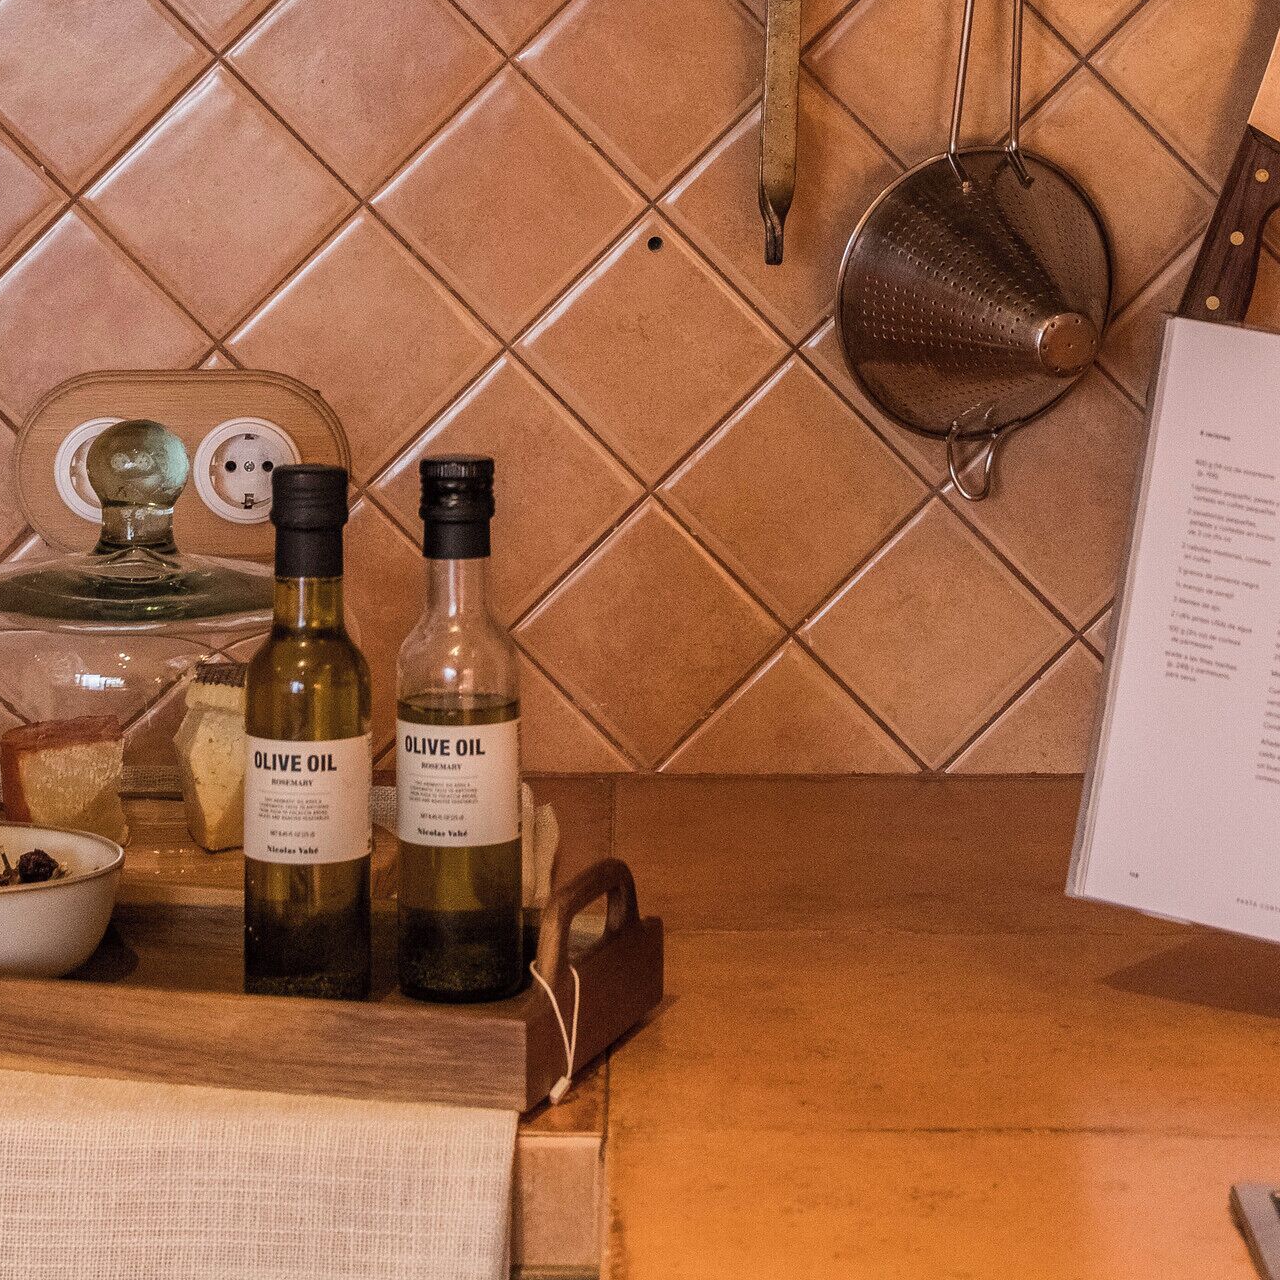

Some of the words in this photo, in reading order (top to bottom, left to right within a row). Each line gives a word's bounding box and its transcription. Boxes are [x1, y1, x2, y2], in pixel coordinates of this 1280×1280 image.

[403, 734, 451, 757] OLIVE
[455, 738, 486, 757] OIL
[254, 750, 302, 773] OLIVE
[307, 753, 338, 773] OIL
[421, 761, 463, 771] ROSEMARY
[271, 777, 314, 788] ROSEMARY
[417, 826, 446, 838] Nicolas
[266, 844, 297, 856] Nicolas
